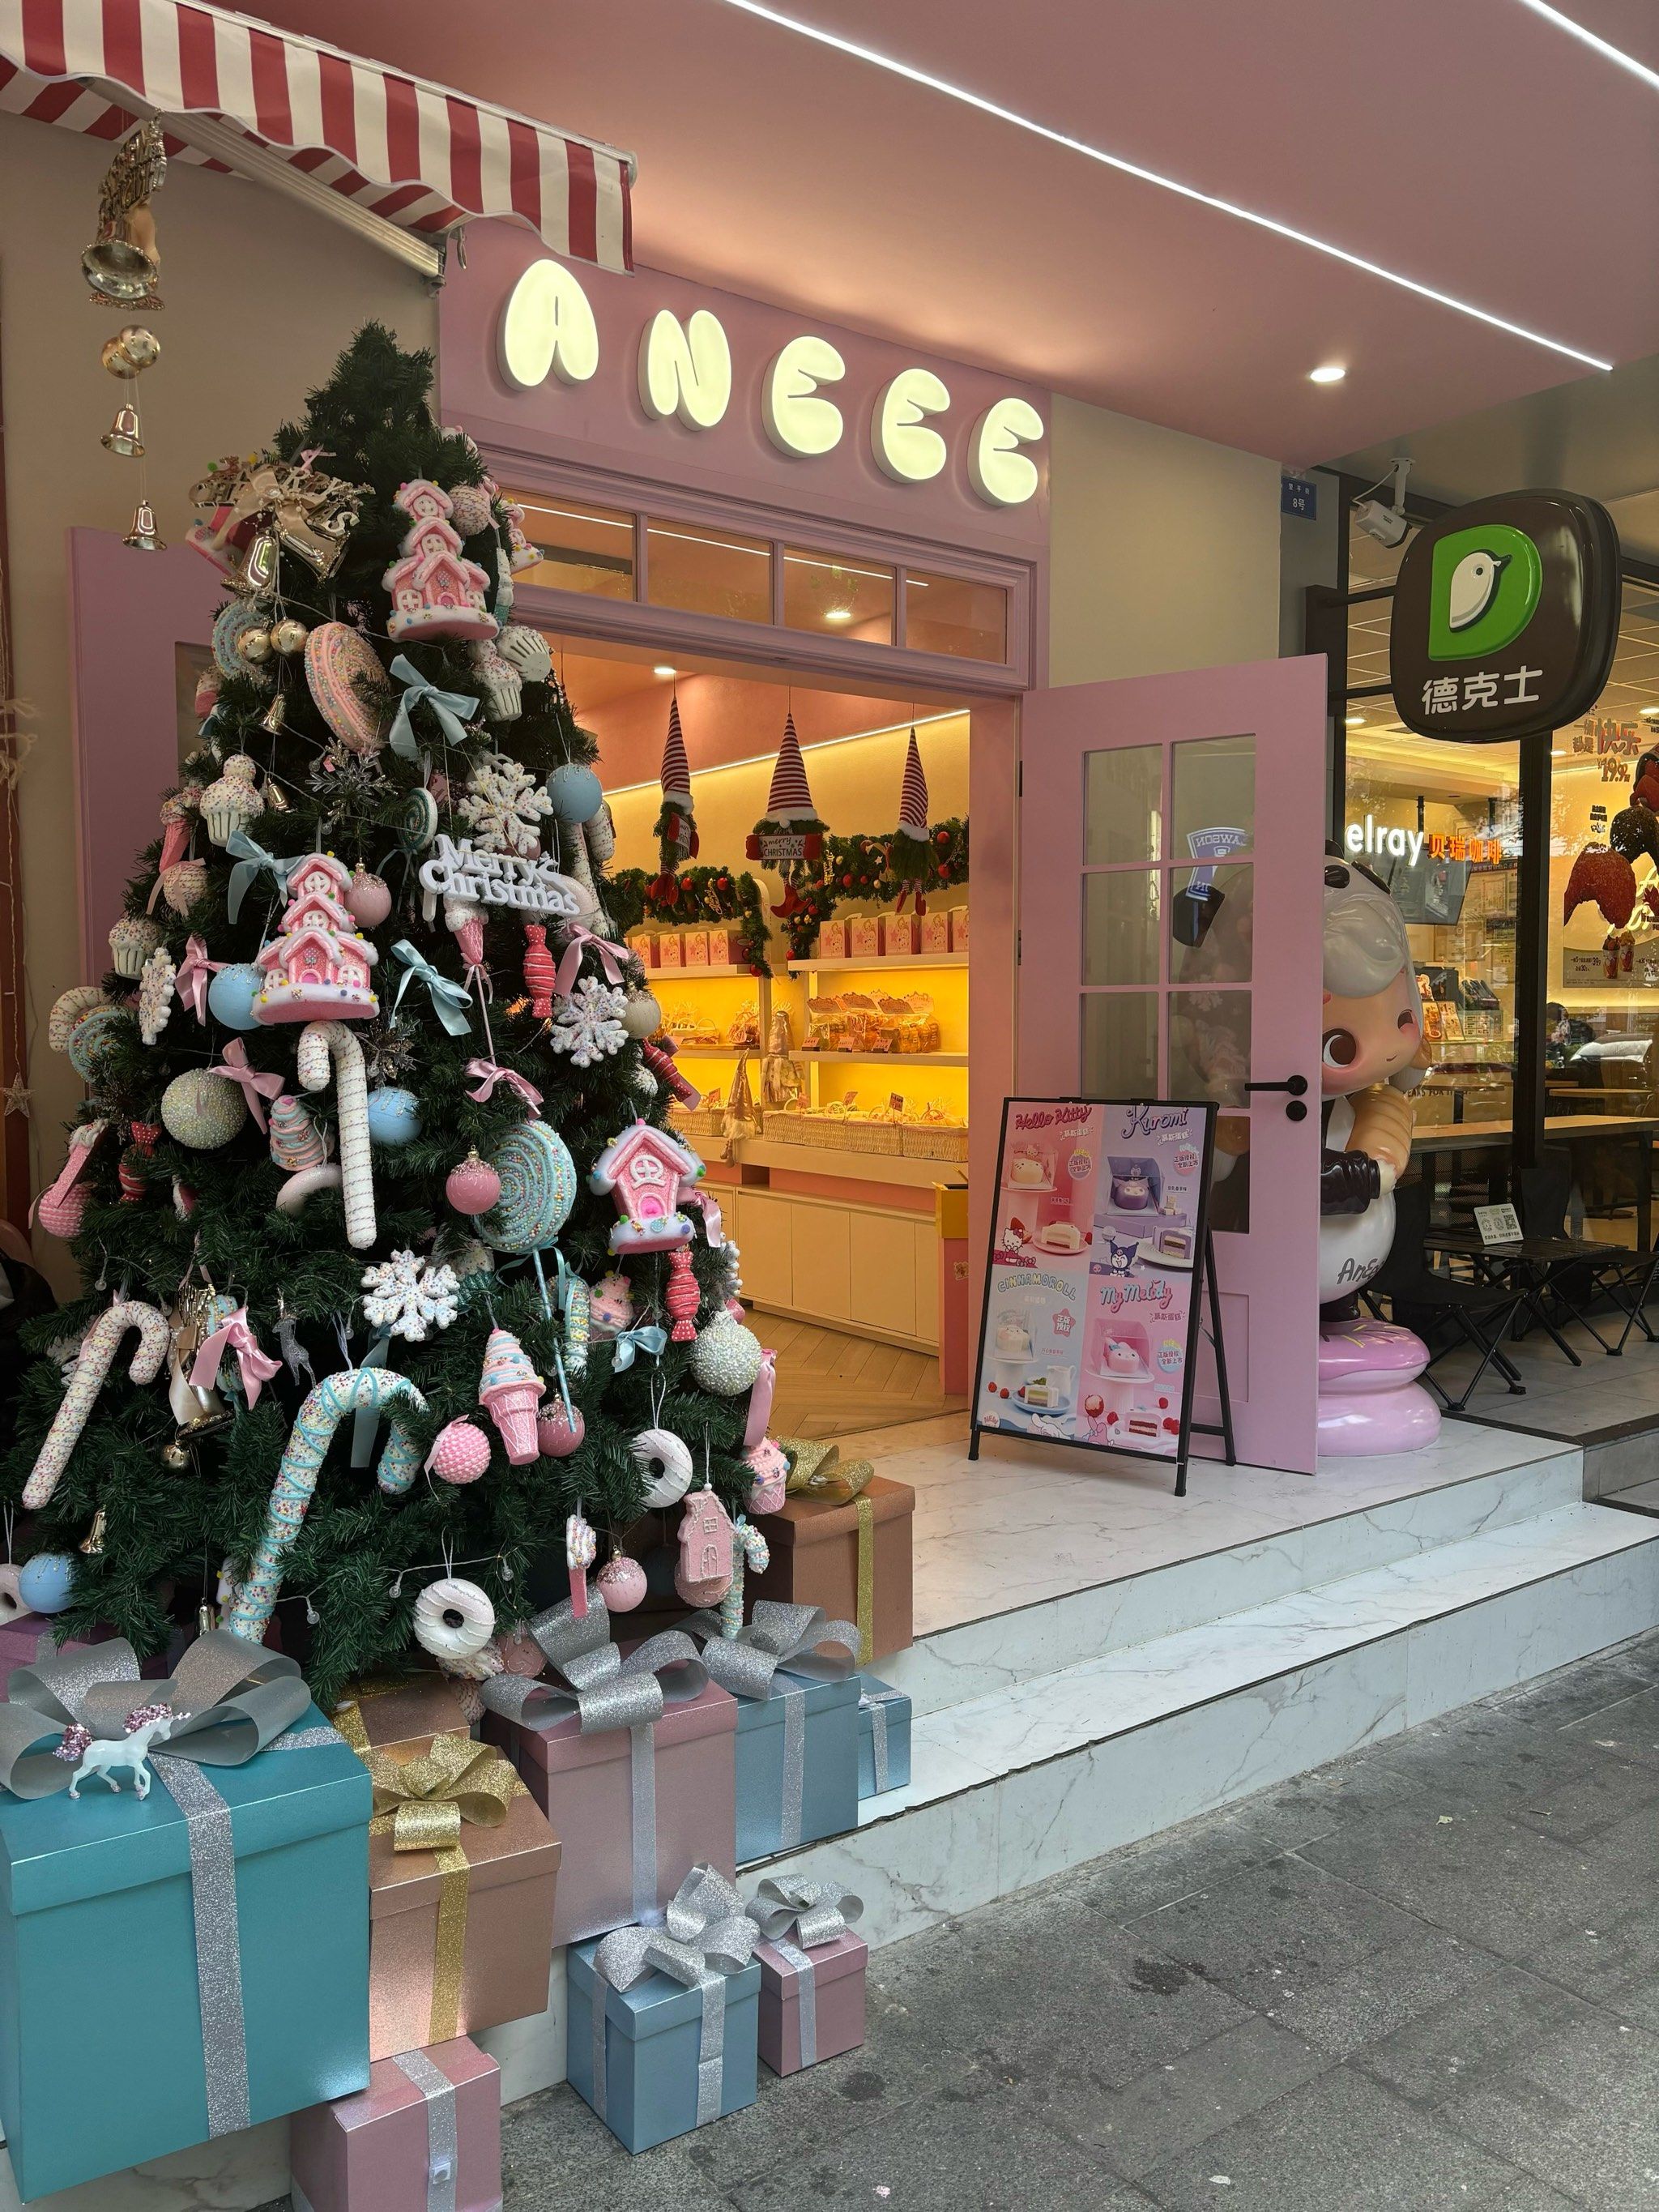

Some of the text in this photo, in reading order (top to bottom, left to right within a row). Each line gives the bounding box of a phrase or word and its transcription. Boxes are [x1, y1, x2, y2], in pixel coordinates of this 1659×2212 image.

[1421, 664, 1543, 715] 德克士
[1595, 718, 1641, 755] 快乐
[763, 848, 803, 856] CHRISTMAS
[768, 837, 791, 845] merry
[1428, 834, 1503, 865] 贝瑞咖啡
[434, 834, 559, 886] Merry
[418, 859, 580, 916] Christmas
[1015, 1105, 1092, 1129] Hello Kitty
[1121, 1105, 1189, 1139] Kuromi
[997, 1273, 1077, 1301] CINNAMOROLL
[1101, 1279, 1173, 1313] My Melody
[1056, 1322, 1070, 1332] 授权
[1057, 1314, 1071, 1324] 正版
[1158, 1350, 1179, 1358] 正版授权
